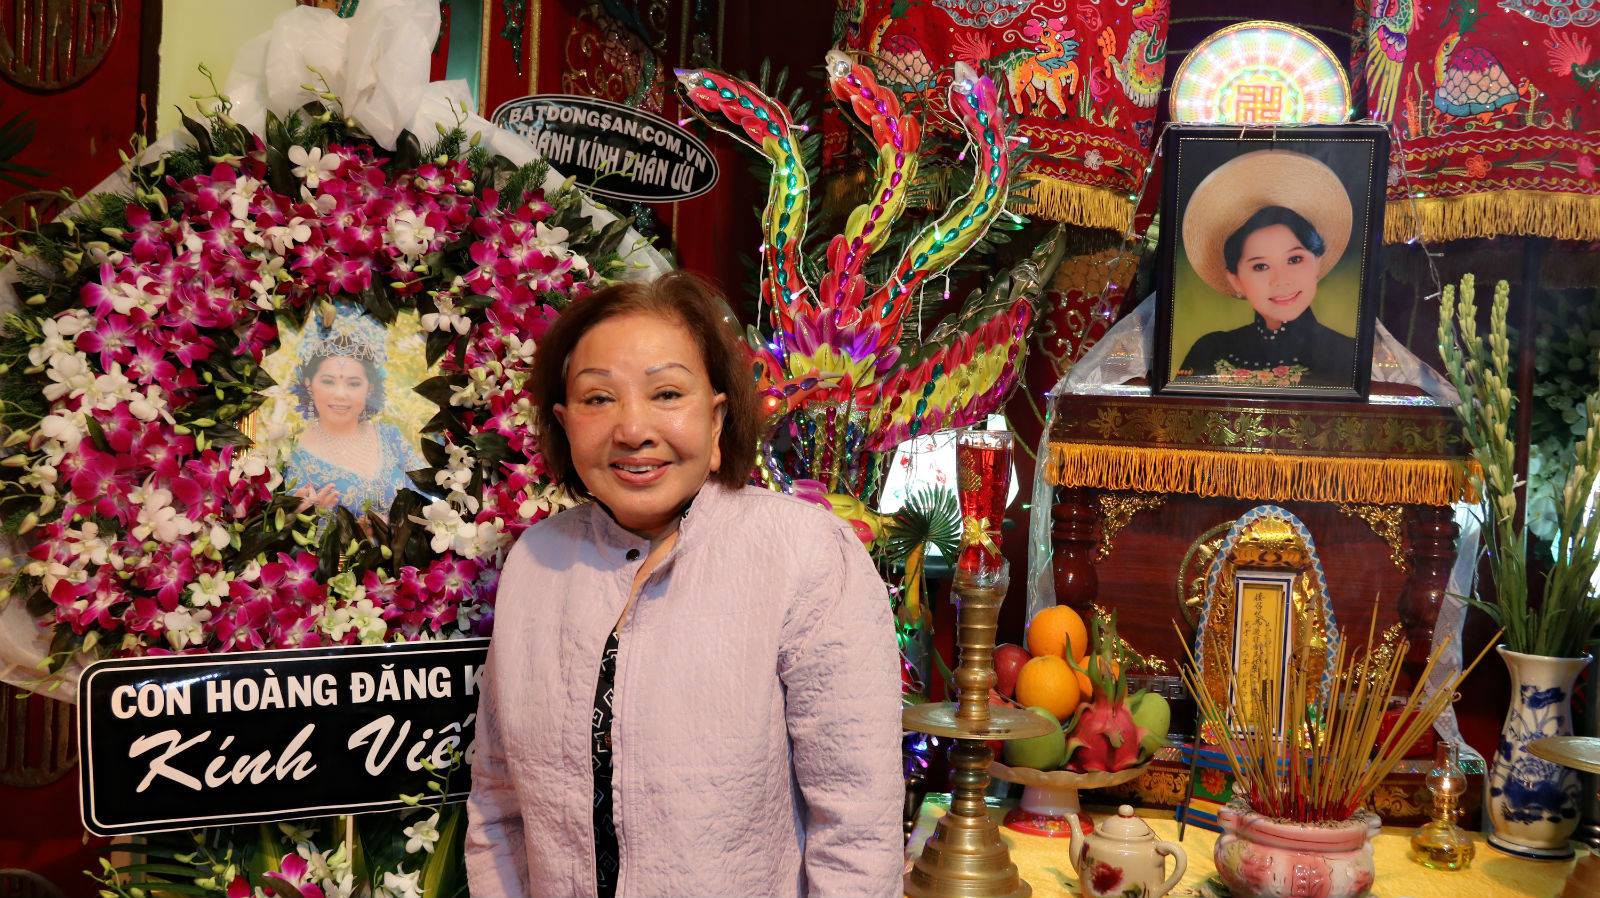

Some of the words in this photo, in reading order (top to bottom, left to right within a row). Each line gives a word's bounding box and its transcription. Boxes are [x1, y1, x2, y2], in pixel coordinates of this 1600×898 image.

[576, 136, 621, 175] KÍNH
[622, 150, 670, 187] PHÂN
[111, 683, 192, 719] CON
[206, 668, 338, 713] HOÀNG
[350, 663, 452, 704] ĐĂNG
[128, 723, 317, 793] Kính
